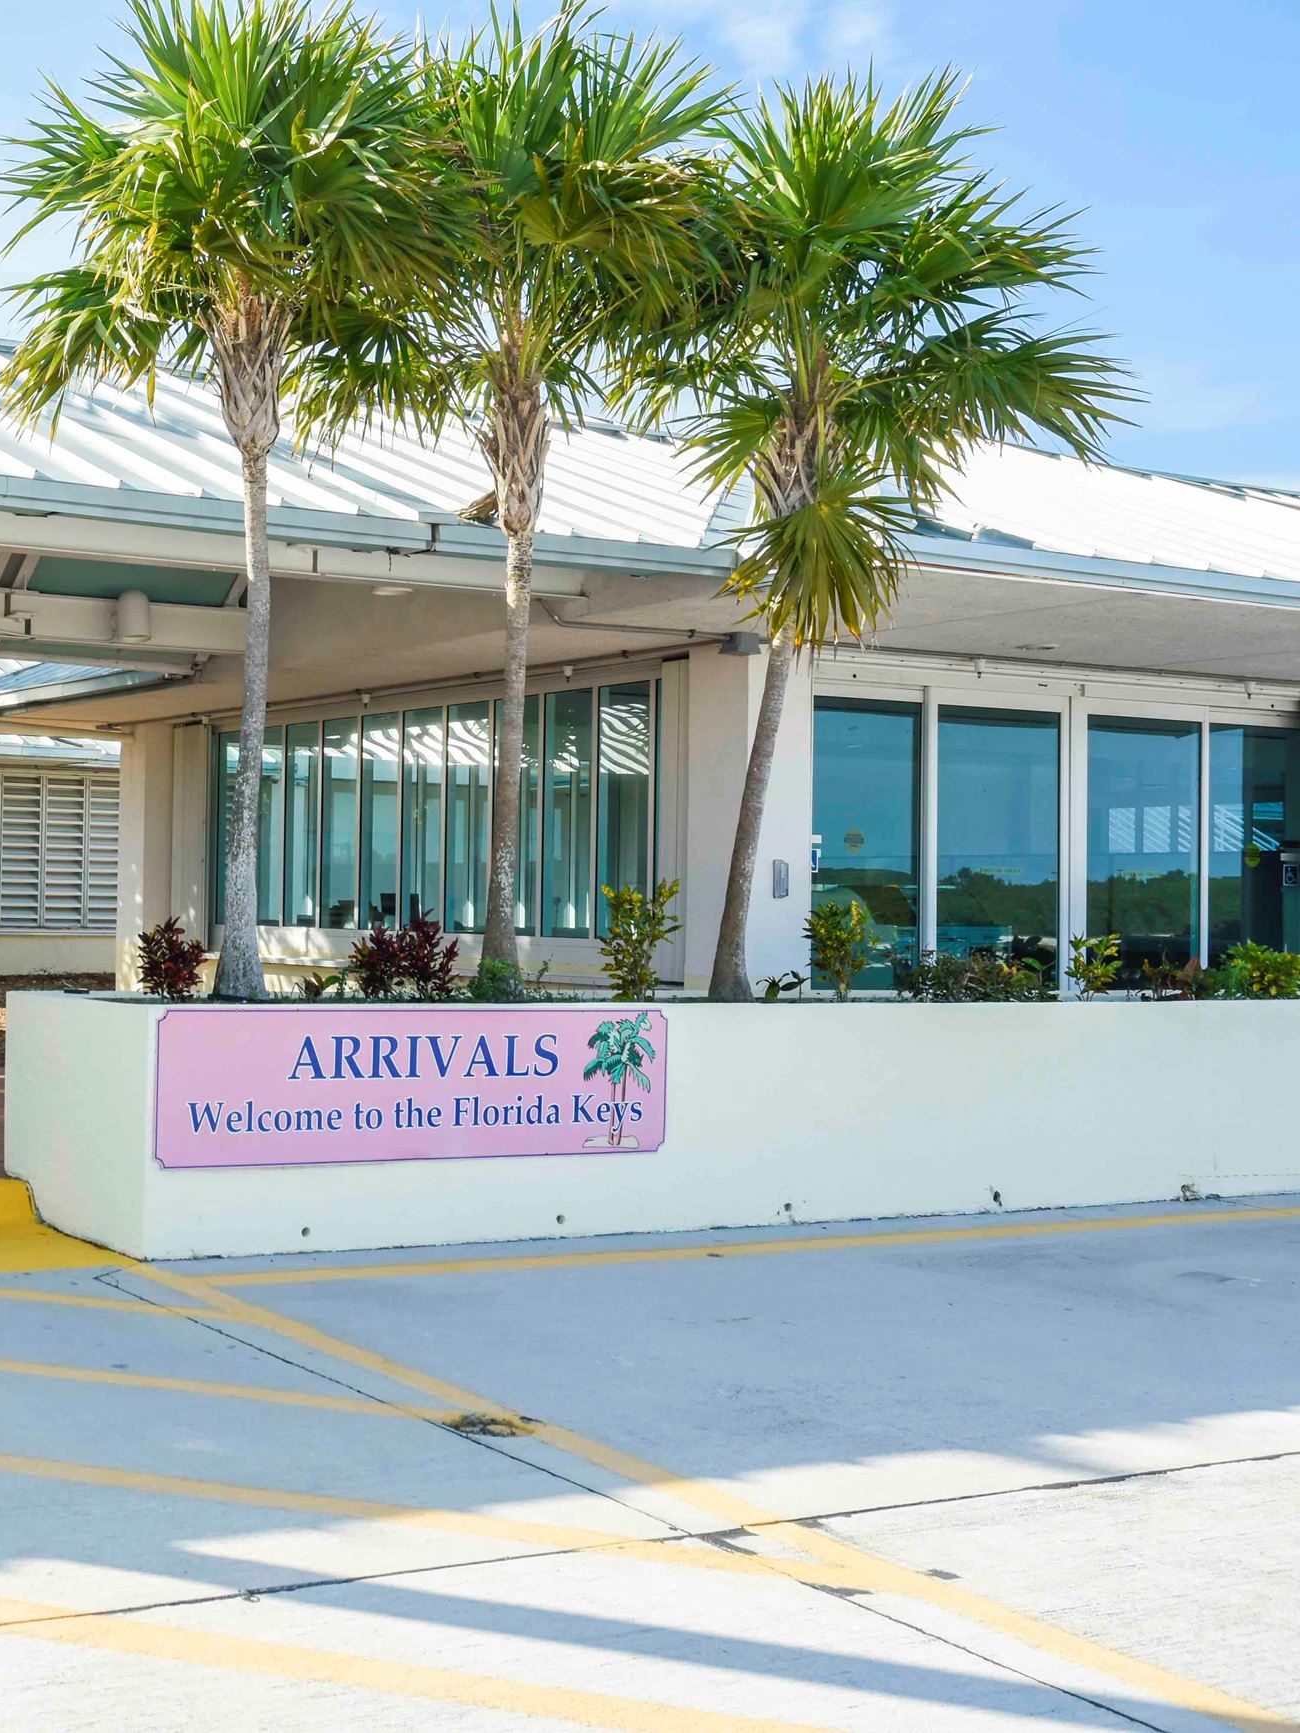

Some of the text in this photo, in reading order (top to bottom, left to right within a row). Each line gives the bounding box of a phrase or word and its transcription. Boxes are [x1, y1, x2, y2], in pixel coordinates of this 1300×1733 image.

[287, 1033, 561, 1081] ARRIVALS
[187, 1093, 643, 1135] Welcome to the Florida Keys
